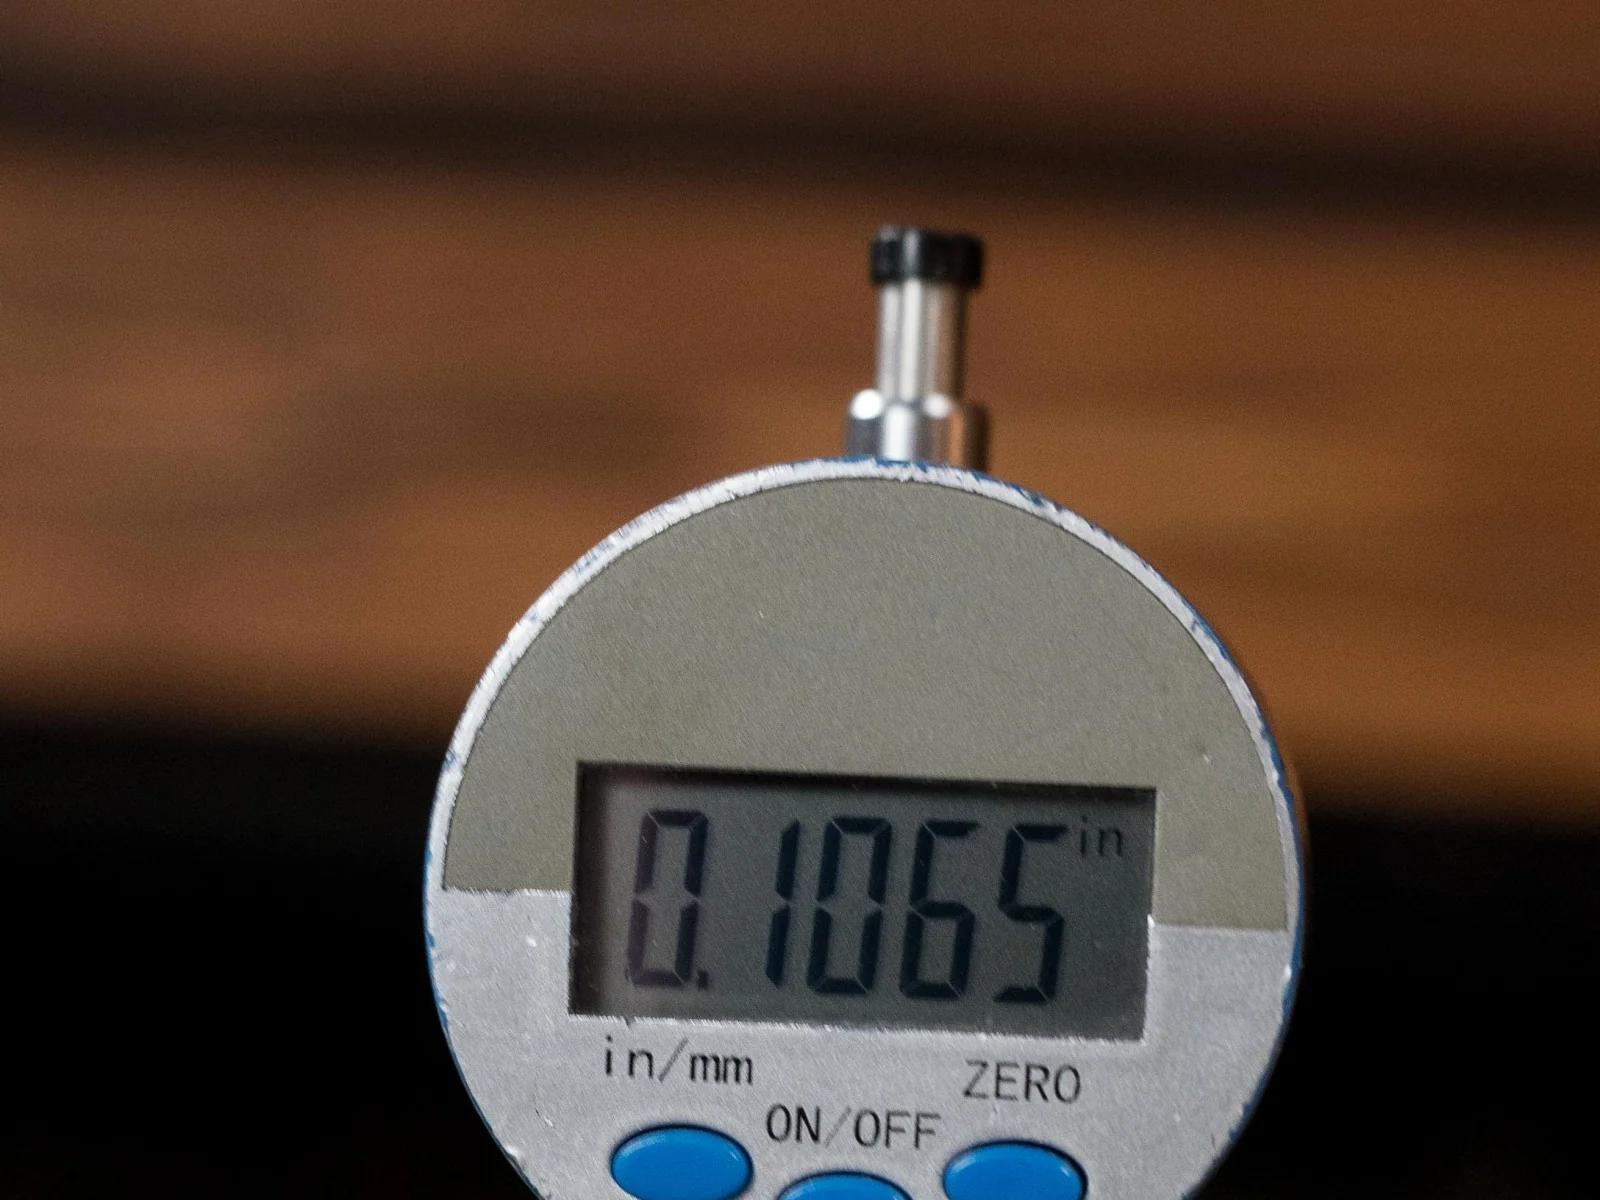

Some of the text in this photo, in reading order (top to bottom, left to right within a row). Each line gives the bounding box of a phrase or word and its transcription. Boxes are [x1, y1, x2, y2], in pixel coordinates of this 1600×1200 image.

[624, 809, 1124, 1004] 0.1065 in
[603, 1035, 754, 1086] in/mm
[962, 1060, 1082, 1103] ZERO
[765, 1103, 942, 1150] ON/OFF
